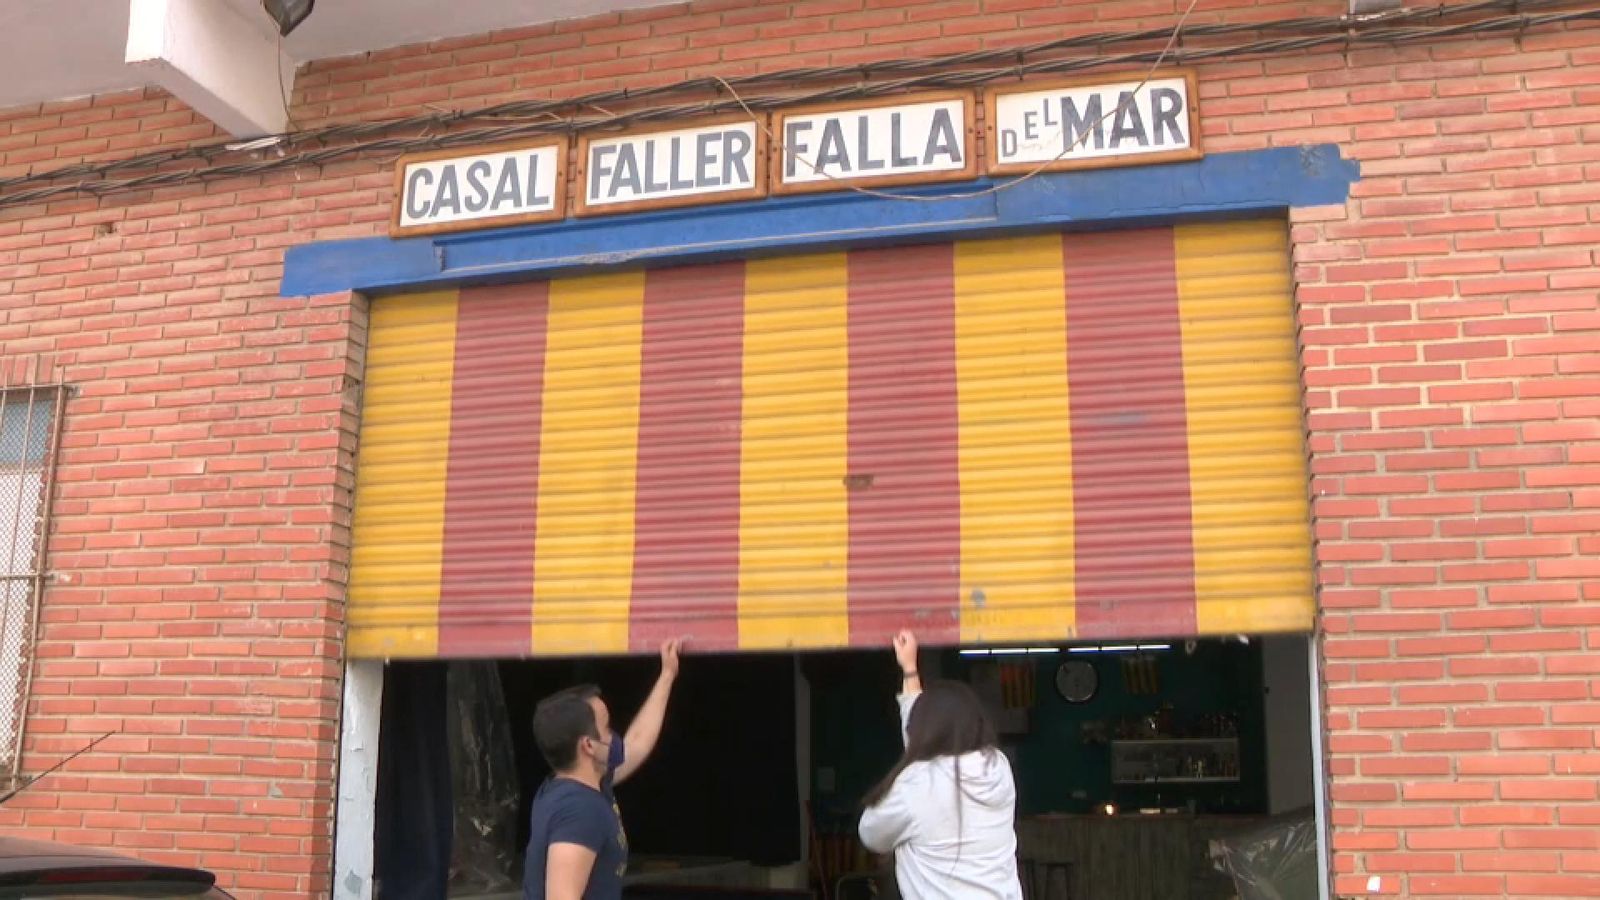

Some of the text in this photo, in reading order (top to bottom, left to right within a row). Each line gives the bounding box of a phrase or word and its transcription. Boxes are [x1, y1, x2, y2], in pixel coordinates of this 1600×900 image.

[406, 87, 1186, 218] CASAL FALLER FALLA DEL MAR
